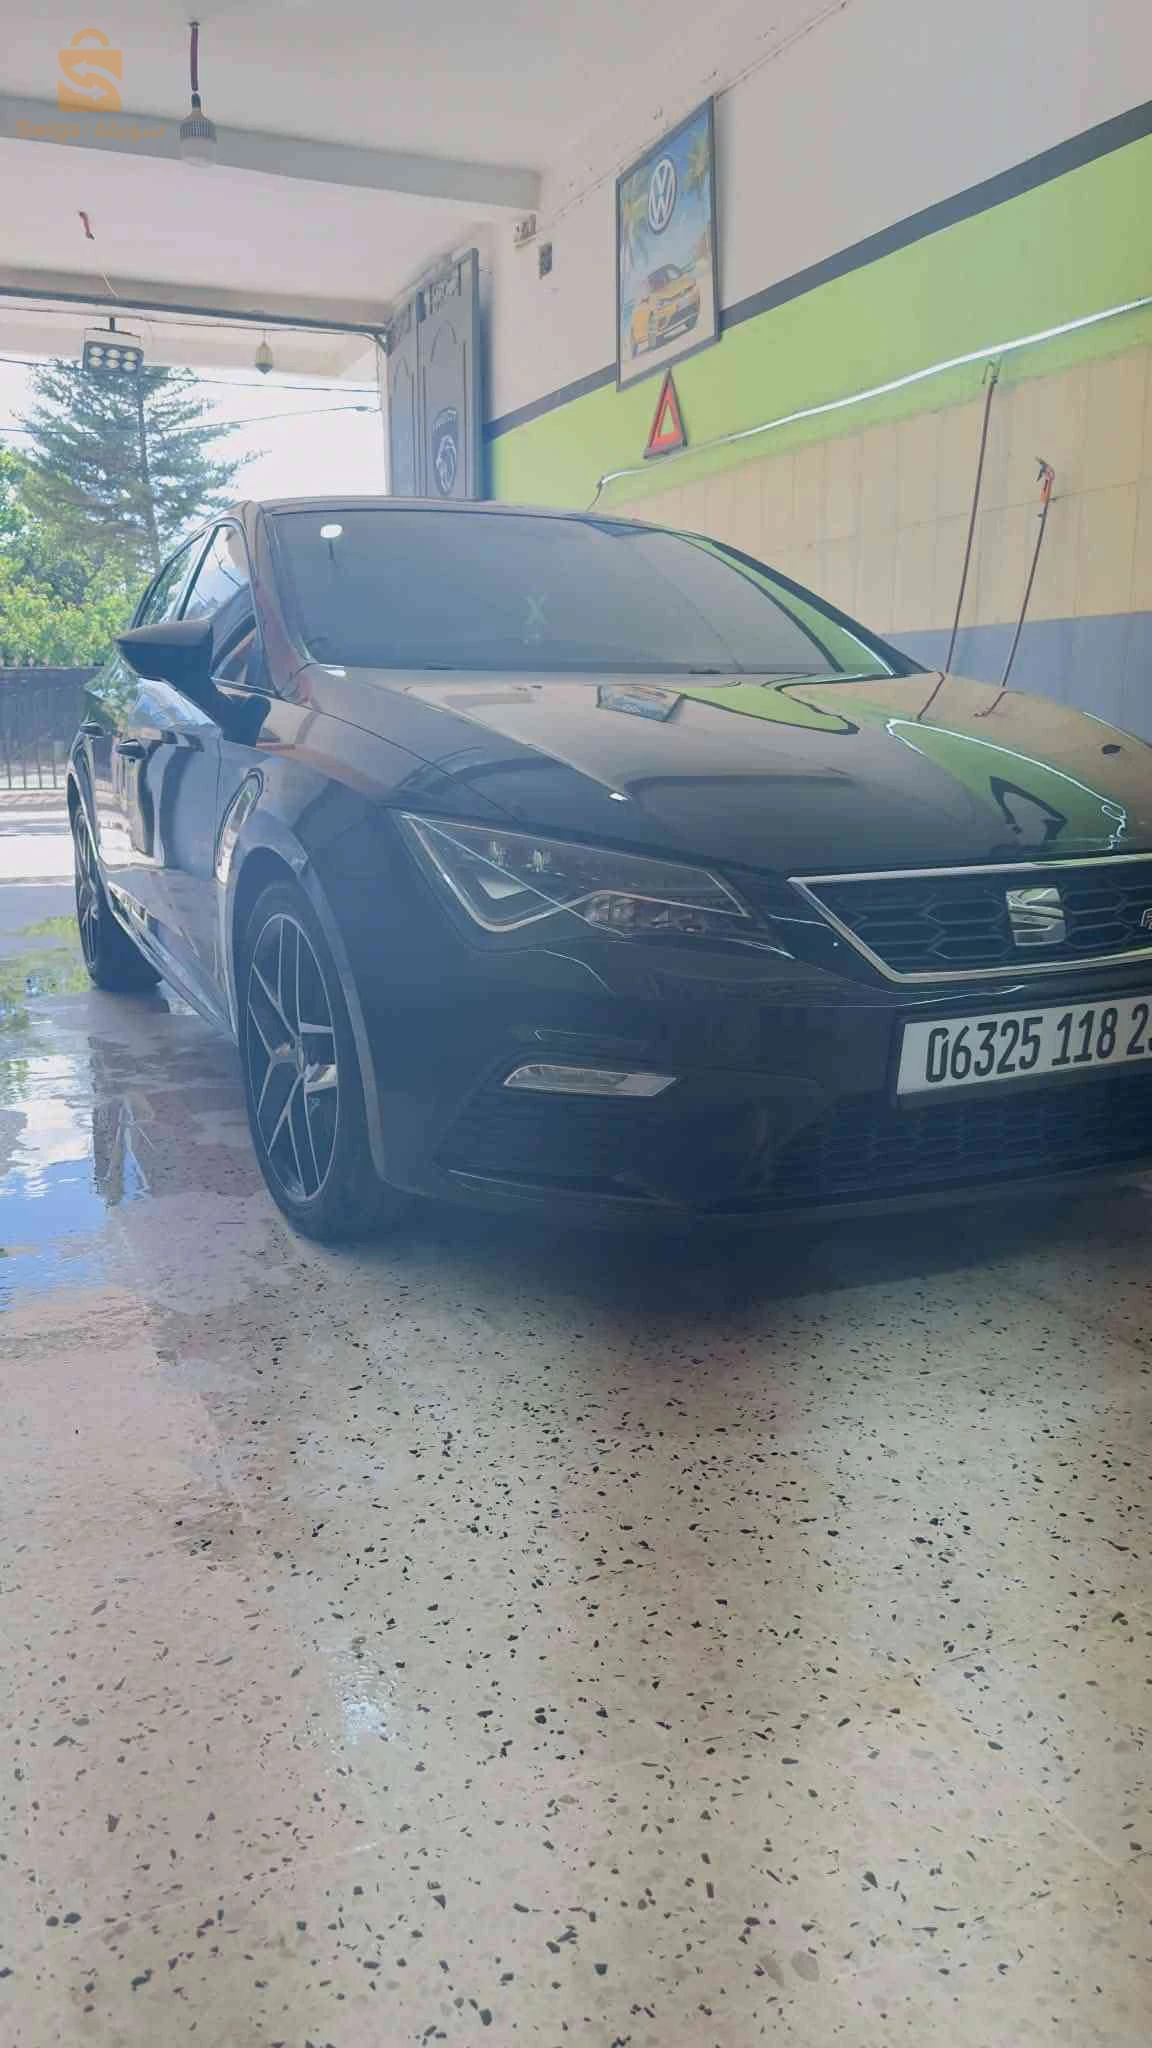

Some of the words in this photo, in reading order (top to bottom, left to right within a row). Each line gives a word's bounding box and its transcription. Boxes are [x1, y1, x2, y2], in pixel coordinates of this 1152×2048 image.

[925, 1015, 1044, 1084] 06325
[1051, 1007, 1119, 1067] 118
[1126, 1002, 1152, 1056] 2
